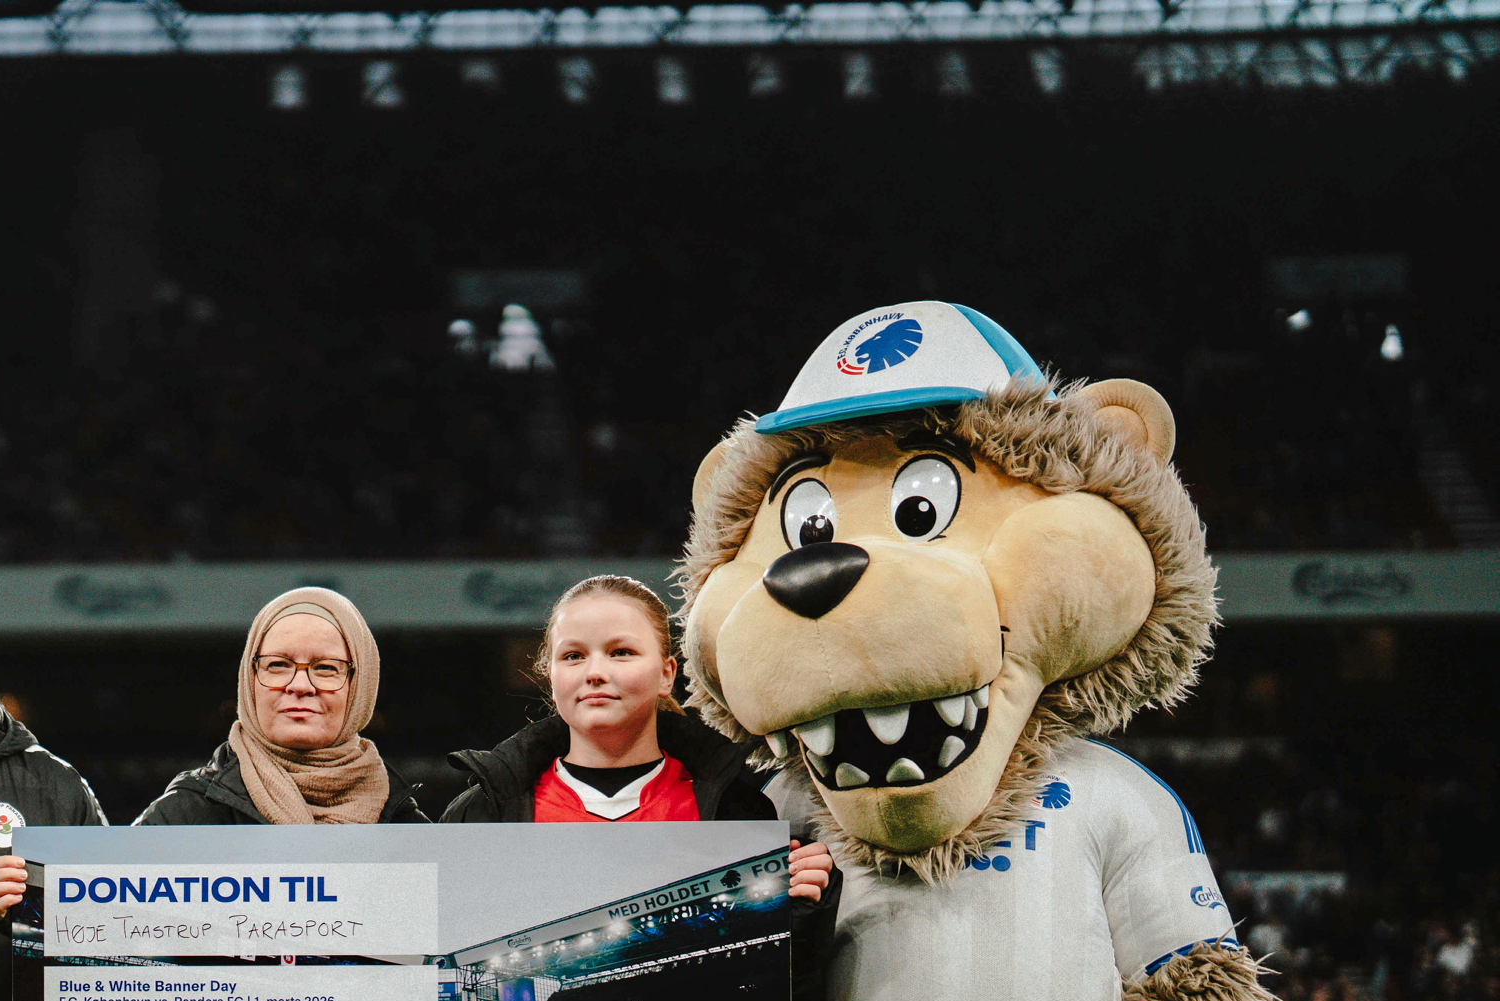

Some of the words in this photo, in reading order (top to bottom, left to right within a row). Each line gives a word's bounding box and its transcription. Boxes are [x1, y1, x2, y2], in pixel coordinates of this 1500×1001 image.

[843, 312, 904, 347] KØBENHAVN
[58, 876, 270, 903] DONATION
[280, 876, 338, 903] TIL
[608, 903, 640, 919] MED
[644, 880, 711, 911] HOLDET
[55, 915, 106, 944] HØJE
[229, 914, 363, 940] PARASPORT
[59, 980, 91, 992] Blue
[95, 980, 104, 992] &
[108, 980, 150, 992] White
[155, 980, 206, 992] Banner
[210, 980, 237, 994] Day
